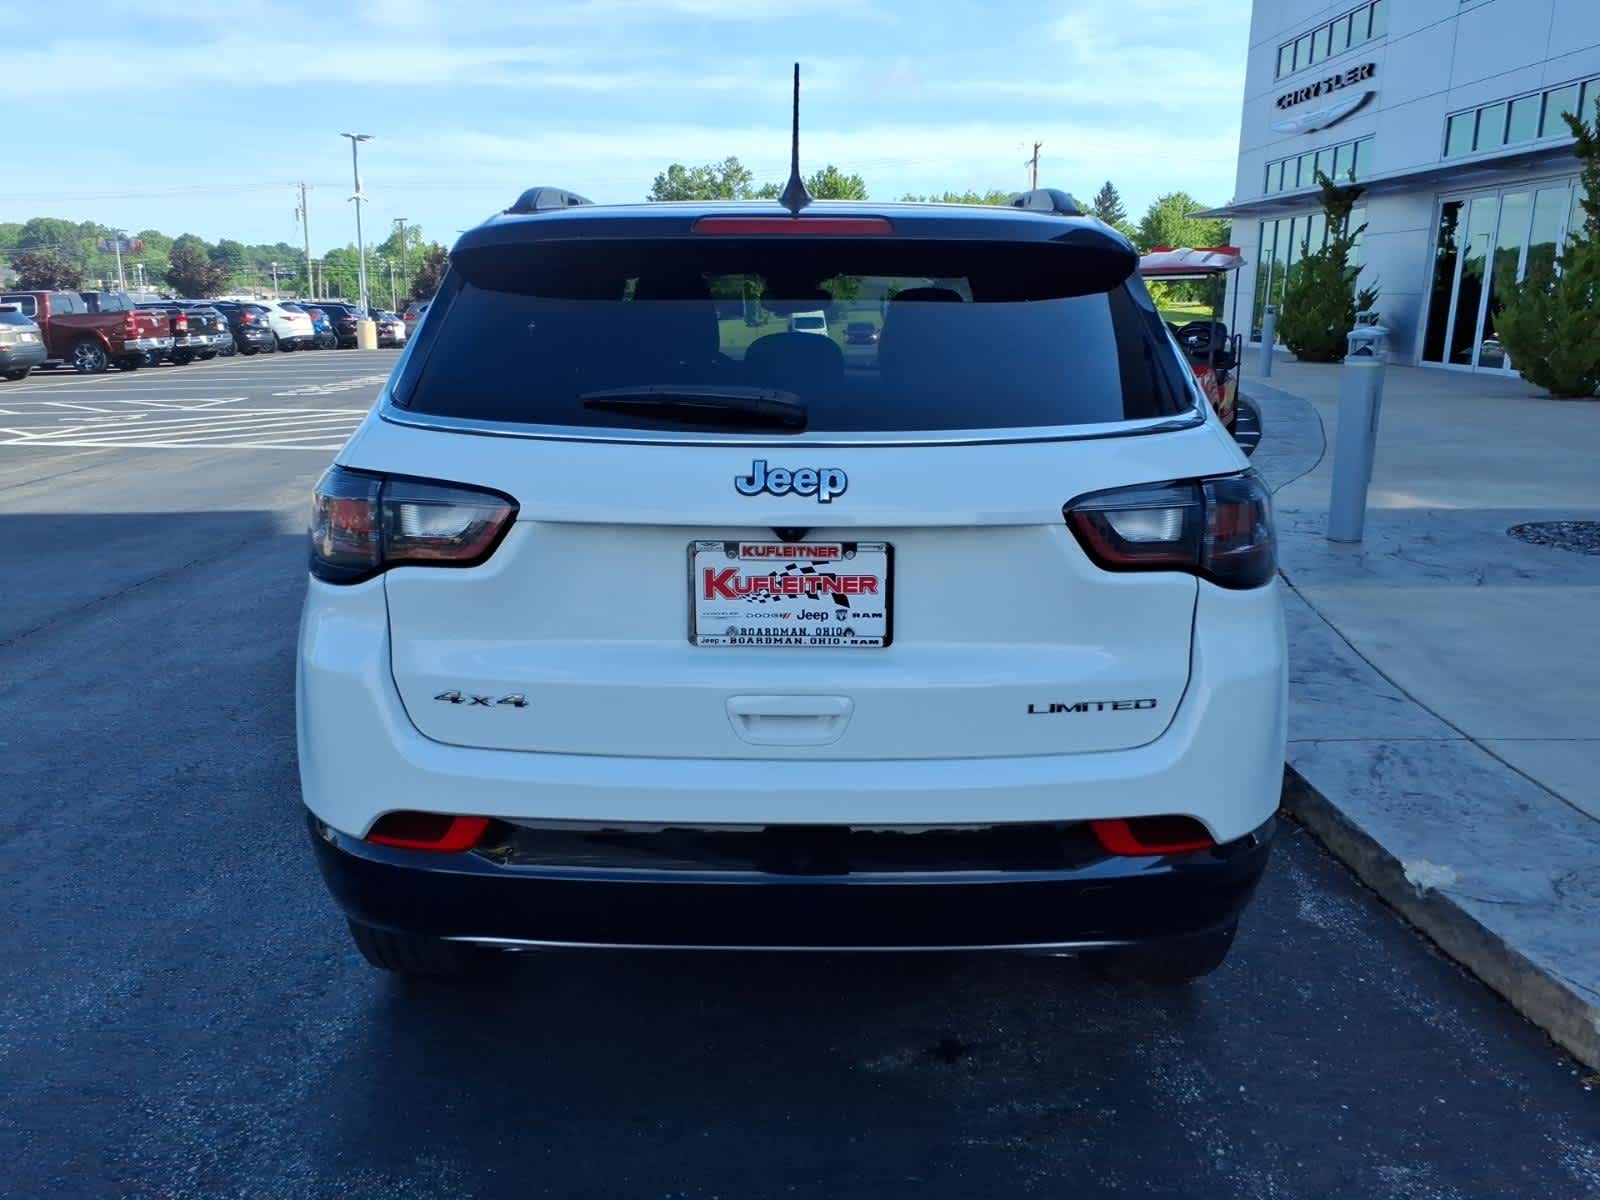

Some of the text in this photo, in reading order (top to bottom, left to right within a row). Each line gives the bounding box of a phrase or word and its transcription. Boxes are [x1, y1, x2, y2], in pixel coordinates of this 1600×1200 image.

[1276, 62, 1376, 110] CHRYSLER
[735, 459, 848, 504] Jeep
[741, 545, 839, 558] KUFLEITNER
[703, 567, 879, 600] KUFLEITNER
[796, 609, 829, 622] Jeep
[815, 627, 842, 637] OHIO
[701, 636, 720, 645] Jeep
[809, 637, 840, 645] OHIO
[433, 689, 529, 708] 4x4
[1028, 698, 1157, 714] LIMITED
